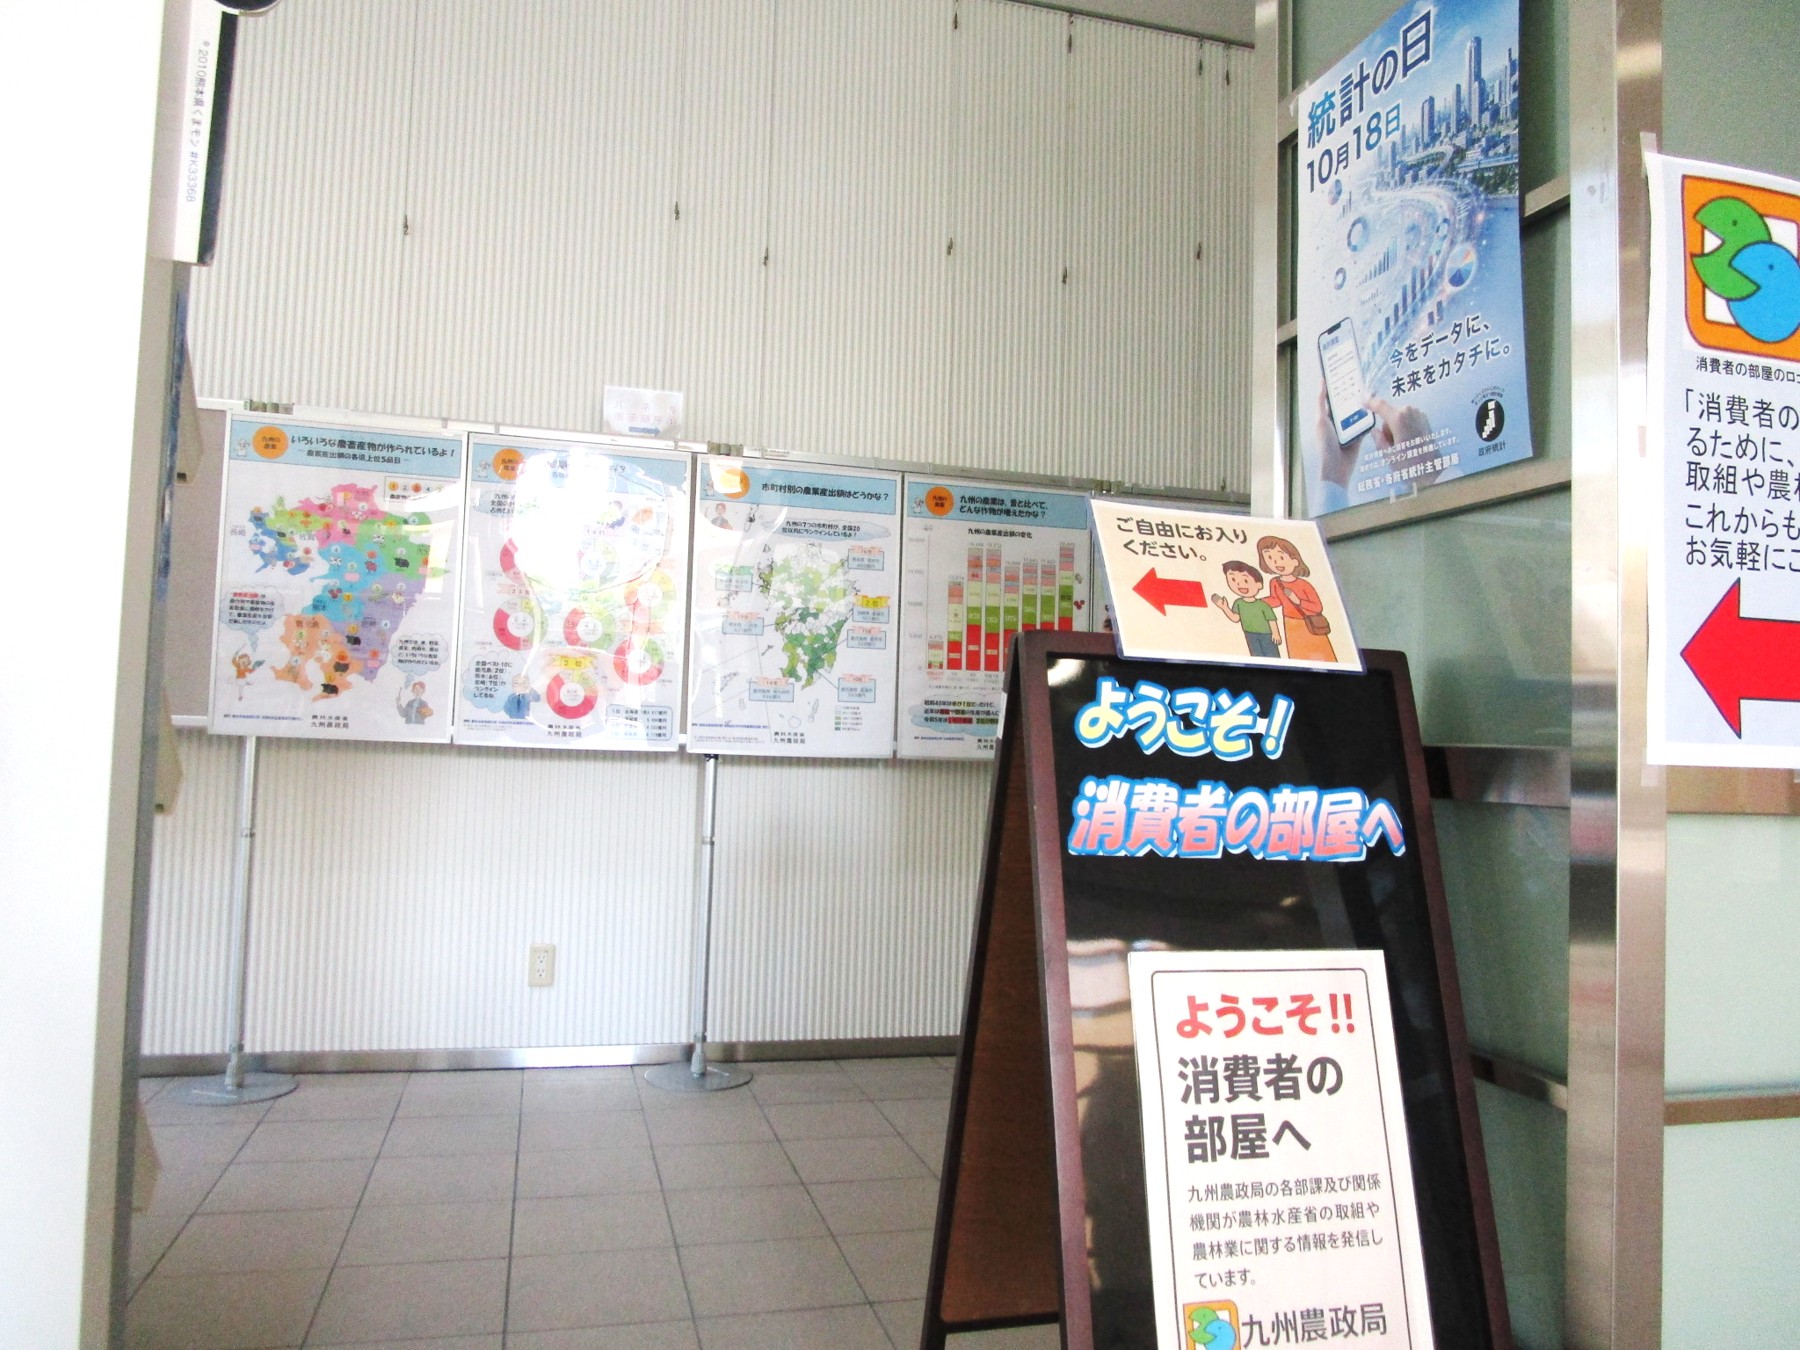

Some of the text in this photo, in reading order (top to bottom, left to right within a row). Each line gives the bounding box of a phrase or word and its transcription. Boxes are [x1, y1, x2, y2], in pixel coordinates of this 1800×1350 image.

[1308, 9, 1432, 149] 統計の日
[1307, 102, 1400, 193] 10月18日
[1390, 315, 1489, 368] 今をデータに、
[1391, 337, 1510, 397] 未来をカタチに。
[1686, 388, 1800, 430] 「消費者の
[1686, 427, 1795, 467] るために、
[1116, 516, 1247, 544] ご自由にお入り
[1686, 503, 1800, 541] これからも
[1124, 539, 1207, 562] ください。
[1074, 676, 1295, 761] ようこそ！
[1068, 775, 1406, 862] 消費者の部屋へ
[1176, 993, 1355, 1039] ようこそ!!
[1177, 1053, 1344, 1105] 消費者の
[1184, 1112, 1312, 1164] 部屋へ
[1187, 1173, 1382, 1203] 九州農政局の各部課及び関係
[1190, 1201, 1380, 1232] 機関が農林水産省の取組や
[1192, 1229, 1383, 1261] 農林業に関する情報を発信し
[1194, 1267, 1257, 1289] ています。
[1241, 1302, 1387, 1349] 九州農政局
